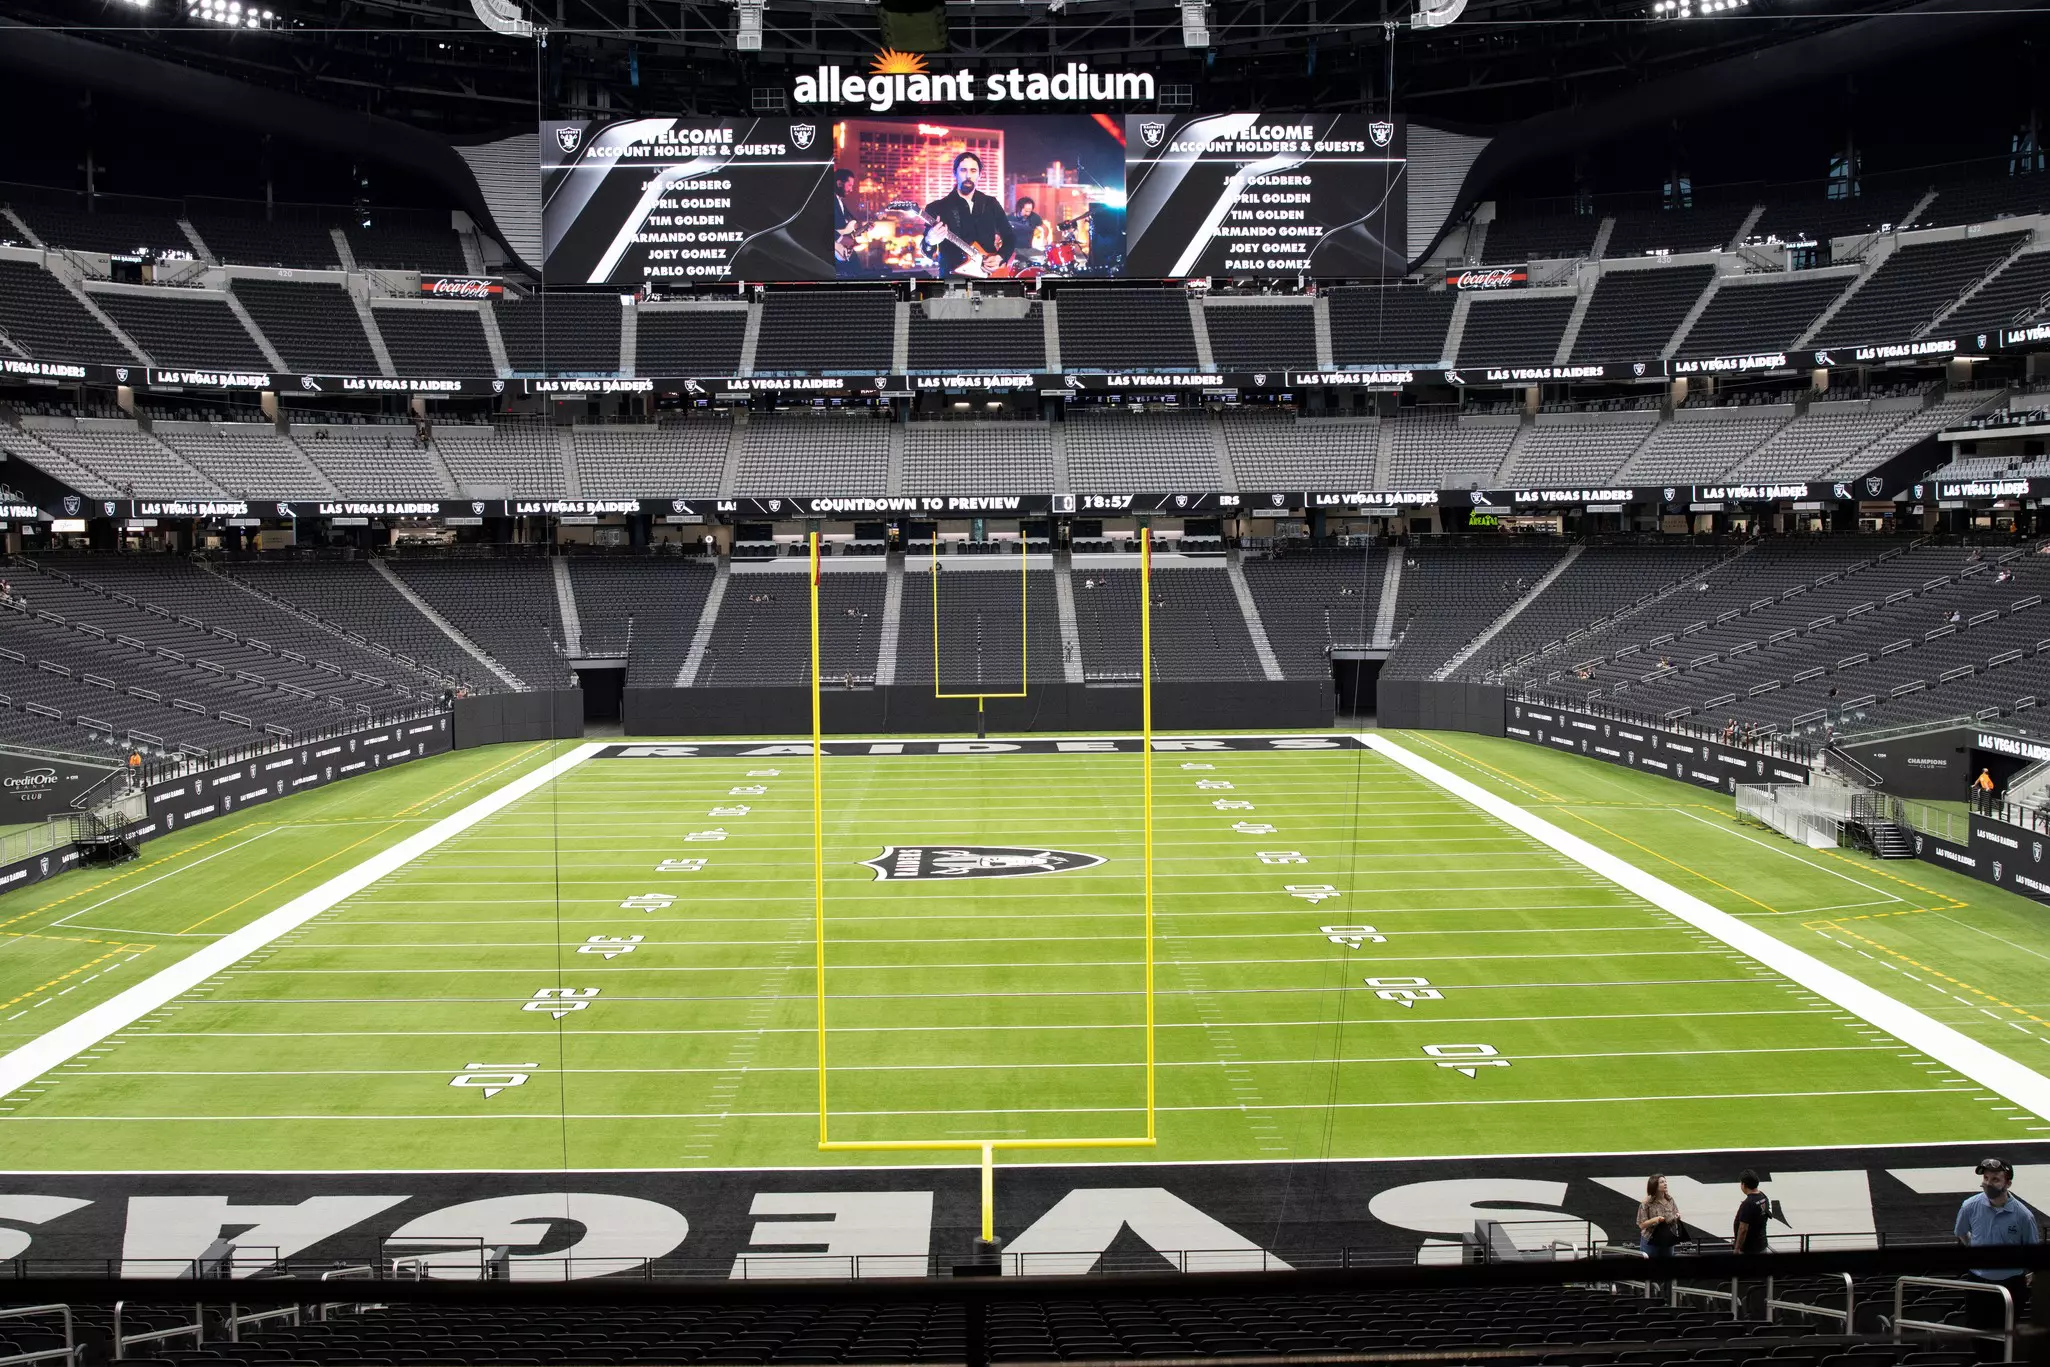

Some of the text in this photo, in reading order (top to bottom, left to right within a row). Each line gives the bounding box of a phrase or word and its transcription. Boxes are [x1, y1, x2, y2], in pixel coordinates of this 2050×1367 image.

[794, 63, 1154, 112] allegiant stadium
[641, 129, 733, 144] WELCOME
[1223, 126, 1313, 140] WELCOME
[586, 144, 786, 158] ACCOUNT HOLDERS & GUESTS
[1170, 142, 1364, 152] ACCOUNT HOLDERS & GUESTS
[641, 180, 731, 191] JOE GOLDBERG
[1224, 176, 1312, 186] JOE GOLDBERG
[681, 199, 730, 208] GOLDEN
[1262, 194, 1310, 204] GOLDEN
[650, 216, 724, 226] TIM GOLDEN
[1231, 210, 1304, 220] TIM GOLDEN
[1212, 226, 1323, 236] ARMANDO GOMEZ
[631, 232, 743, 243] ARMANDO GOMEZ
[648, 249, 726, 260] JOEY GOMEZ
[1230, 244, 1306, 254] JOEY GOMEZ
[644, 266, 731, 276] PABLO GOMEZ
[1226, 260, 1311, 270] PABLO GOMEZ
[1458, 269, 1516, 290] Coca-Cola
[432, 278, 492, 298] Coca-Cola
[2008, 330, 2025, 343] LAS
[1856, 340, 1956, 360] LAS VEGAS RAIDERS
[4, 361, 40, 374] VEGAS
[42, 363, 86, 378] RAIDERS
[1676, 356, 1786, 372] LAS VEGAS RAIDERS
[158, 372, 270, 386] LAS VEGAS RAIDERS
[1296, 374, 1413, 384] LAS VEGAS RAIDERS
[1488, 366, 1604, 380] LAS VEGAS RAIDERS
[344, 379, 462, 391] LAS VEGAS RAIDERS
[536, 382, 654, 392] LAS VEGAS RAIDERS
[728, 380, 844, 390] LAS VEGAS RAIDERS
[918, 377, 1034, 388] LAS VEGAS RAIDERS
[1108, 376, 1223, 386] LAS VEGAS RAIDERS
[1704, 486, 1808, 499] LAS VEGAS RAIDERS
[1944, 482, 2030, 496] LAS VEGAS RAIDERS
[1084, 496, 1131, 508] 18:57
[1220, 496, 1240, 506] ERS
[1316, 494, 1438, 505] LAS VEGAS RAIDERS
[1516, 490, 1634, 502] LAS VEGAS RAIDERS
[142, 504, 248, 515] LAS VEGAS RAIDERS
[320, 503, 440, 514] LAS VEGAS RAIDERS
[517, 502, 640, 513] LAS VEGAS RAIDERS
[811, 497, 1020, 512] COUNTDOWN TO PREVIEW
[10, 506, 38, 518] VEGAS
[617, 738, 1340, 756] RAIDERS
[1978, 734, 1994, 749] LAS
[1994, 738, 2020, 756] VEGAS
[1908, 758, 1947, 766] CHAMPIONS
[4, 774, 58, 787] CreditOne
[1255, 851, 1310, 864] 50
[654, 858, 709, 872] 50
[1284, 884, 1342, 898] 40
[619, 893, 678, 908] 40
[1319, 925, 1388, 943] 30
[576, 934, 646, 954] 30
[1364, 977, 1446, 1000] 20
[521, 988, 602, 1012] 20
[1421, 1044, 1512, 1068] 10
[448, 1062, 540, 1088] 10
